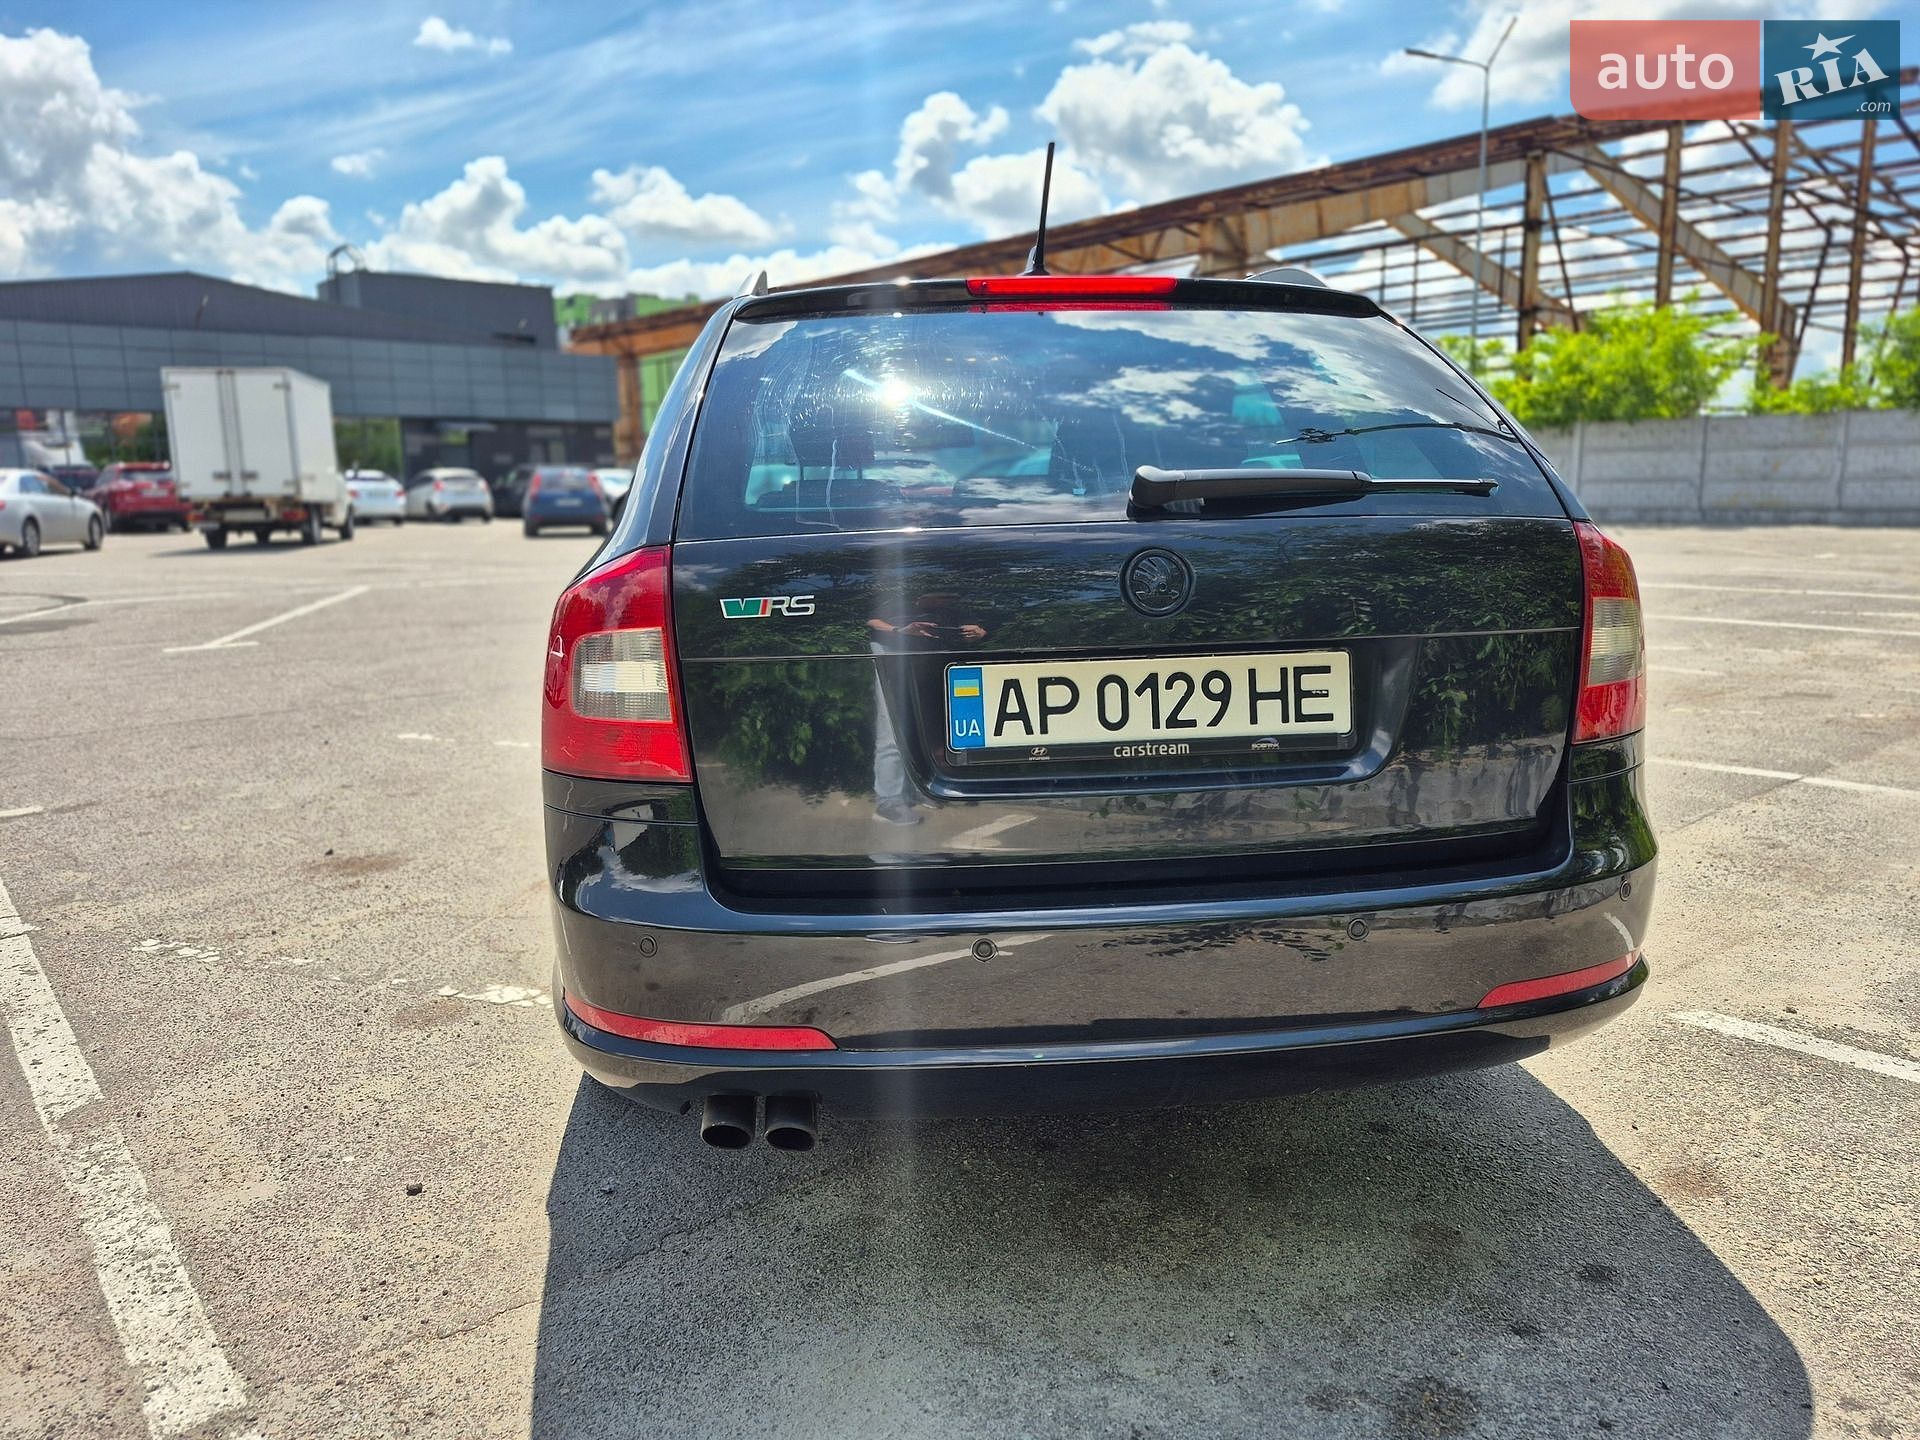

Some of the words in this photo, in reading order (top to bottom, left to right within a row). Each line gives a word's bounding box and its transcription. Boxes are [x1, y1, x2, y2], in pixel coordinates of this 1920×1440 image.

[993, 676, 1080, 737] AP
[1096, 670, 1232, 732] 0129
[1248, 665, 1334, 725] HE
[954, 718, 981, 737] UA
[1113, 742, 1190, 758] carstream
